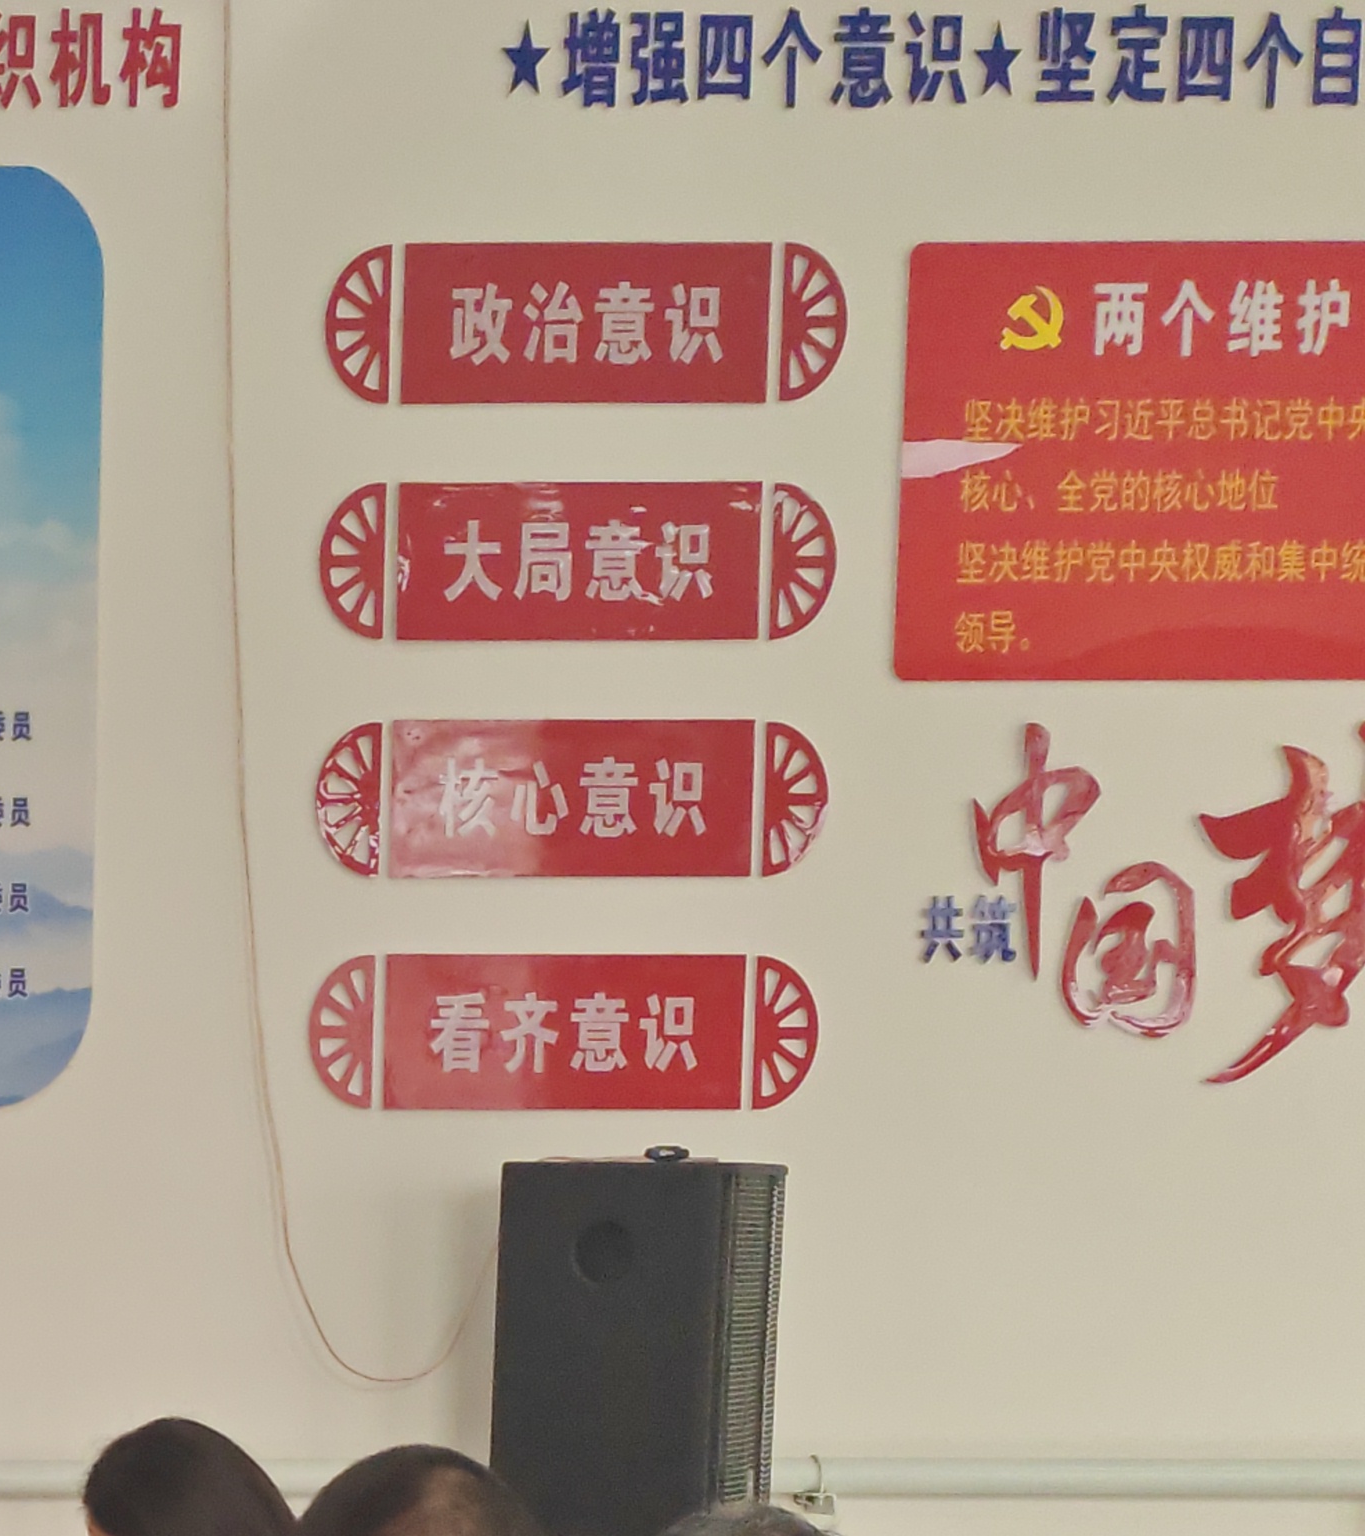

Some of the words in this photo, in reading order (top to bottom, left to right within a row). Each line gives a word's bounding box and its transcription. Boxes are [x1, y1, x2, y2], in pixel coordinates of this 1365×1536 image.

[562, 10, 967, 108] 增强四个意识
[449, 281, 724, 365] 政治意识
[1090, 282, 1353, 357] 两个维护
[959, 469, 1280, 513] 核心、全党的核心地位
[442, 520, 715, 604] 大局意识
[956, 539, 1365, 584] 坚决维护党中央权威和集中统
[953, 610, 1031, 655] 领导。
[436, 756, 707, 838] 核心意识
[919, 894, 1018, 963] 共筑
[429, 993, 698, 1074] 看齐意识
